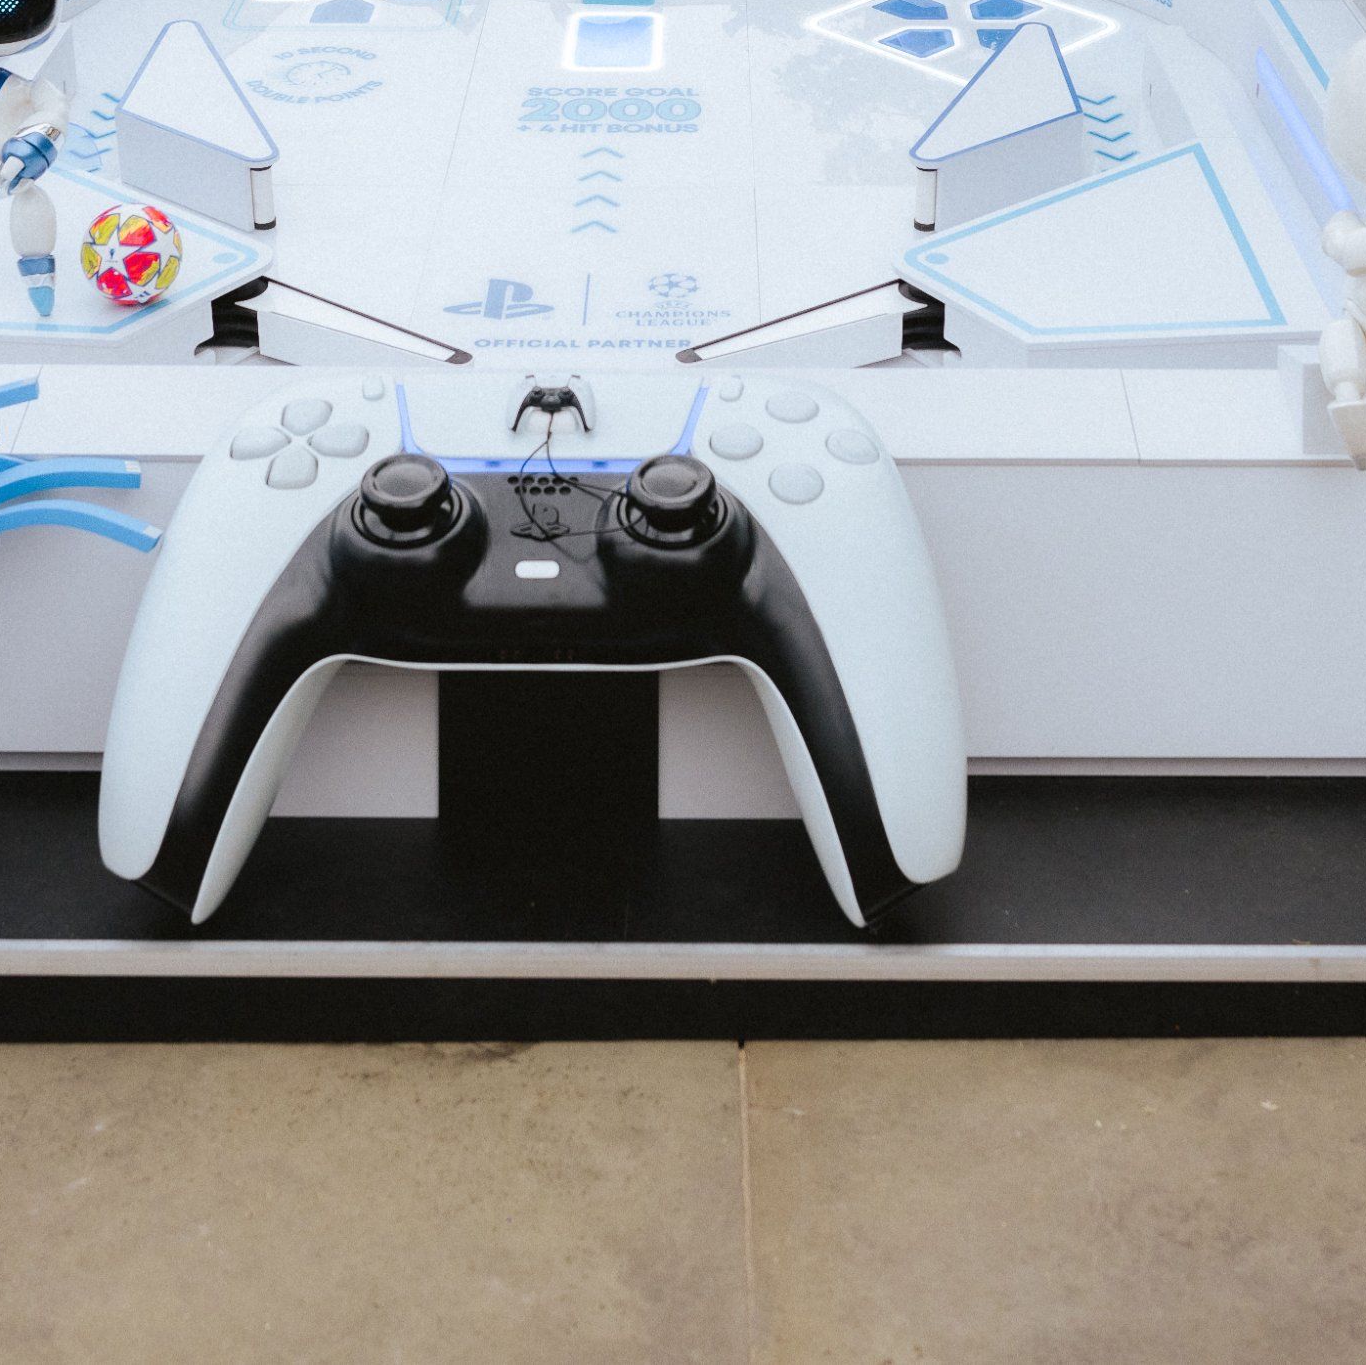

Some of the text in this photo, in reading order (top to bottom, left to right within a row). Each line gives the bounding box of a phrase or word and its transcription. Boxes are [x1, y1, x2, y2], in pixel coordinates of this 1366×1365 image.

[528, 87, 700, 97] SCORE GOAL
[518, 97, 702, 122] 2000
[539, 124, 555, 133] 4
[560, 124, 602, 133] HIT
[607, 124, 699, 133] BONUS
[616, 310, 732, 318] CHAMPIONS
[636, 319, 710, 327] LEAGUE
[474, 338, 691, 349] OFFICIAL PARTNER
